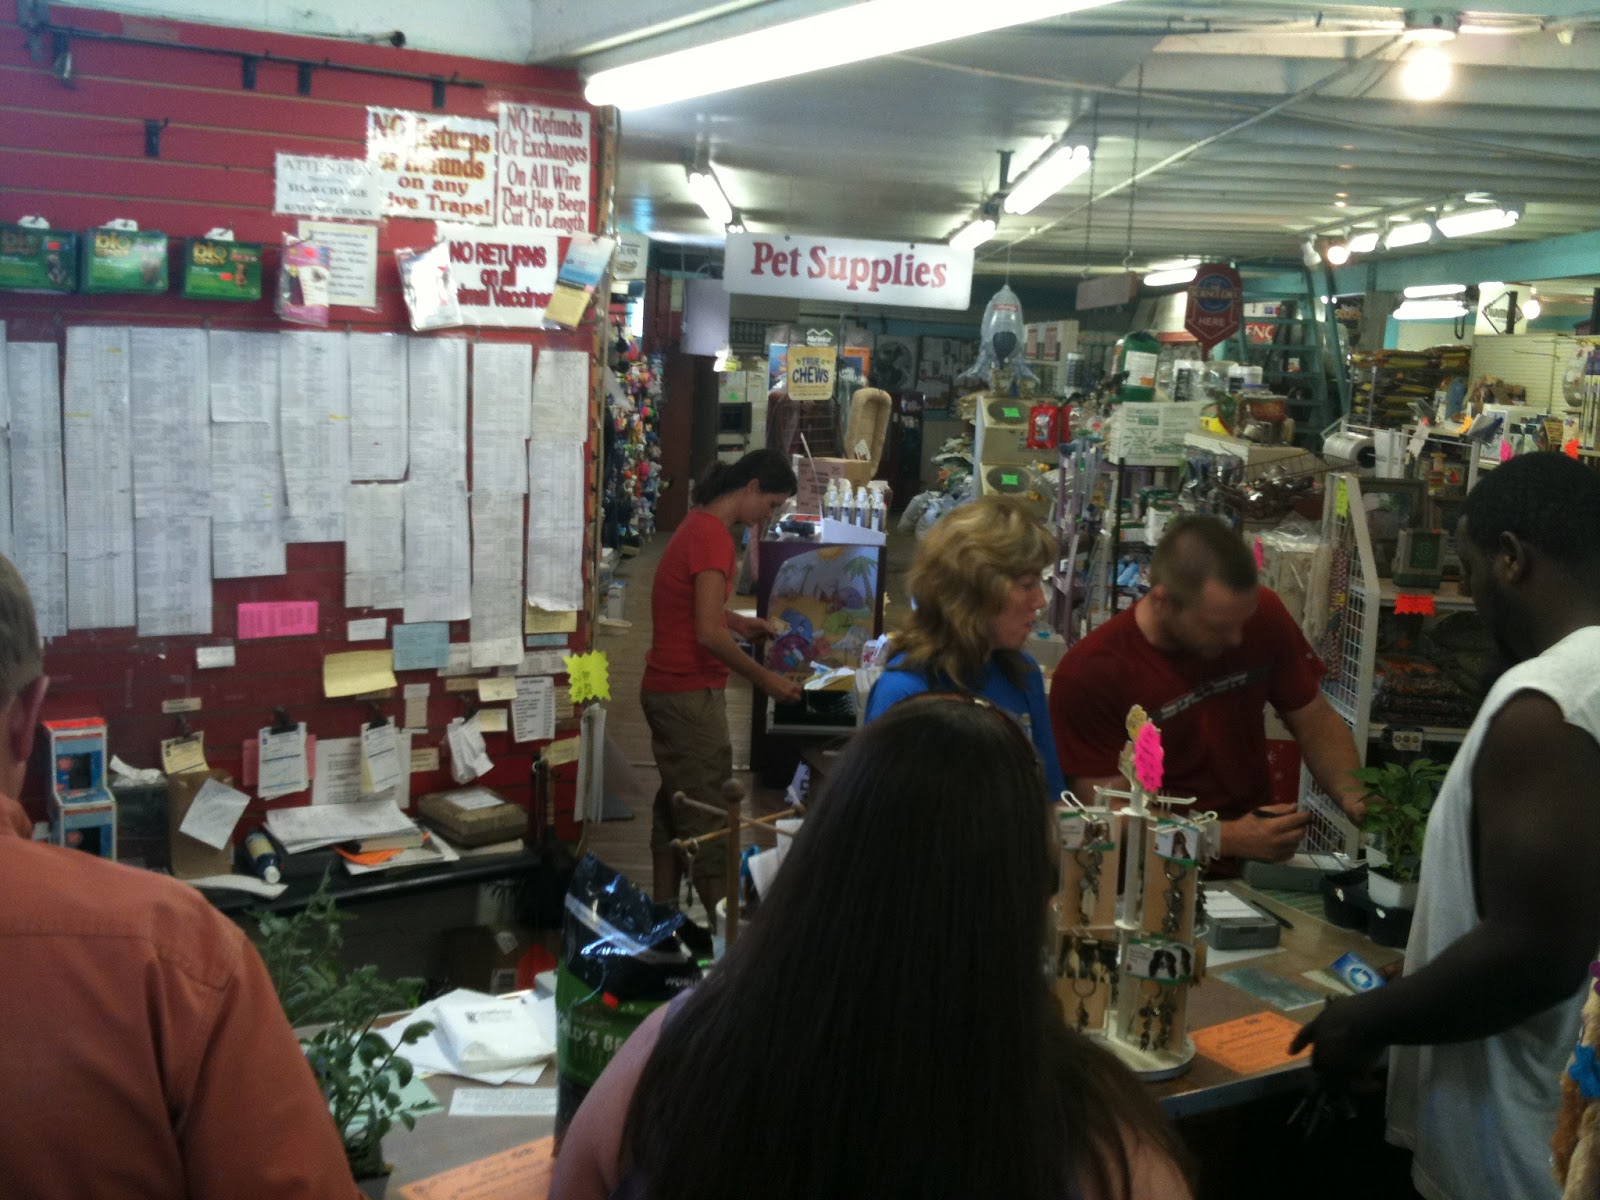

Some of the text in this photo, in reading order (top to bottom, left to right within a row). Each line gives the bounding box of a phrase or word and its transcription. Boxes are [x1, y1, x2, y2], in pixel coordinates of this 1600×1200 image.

[507, 106, 529, 131] NO
[502, 131, 588, 167] Or Exchanges
[398, 176, 469, 198] on any
[507, 161, 581, 191] On All Wire
[426, 194, 490, 217] Traps!
[501, 186, 586, 213] That Has Been
[502, 206, 585, 235] Cut To Length
[449, 241, 547, 268] NO RETURNS
[752, 241, 947, 292] Pet Supplies
[792, 367, 830, 383] CHEWS
[801, 357, 821, 366] TRUE
